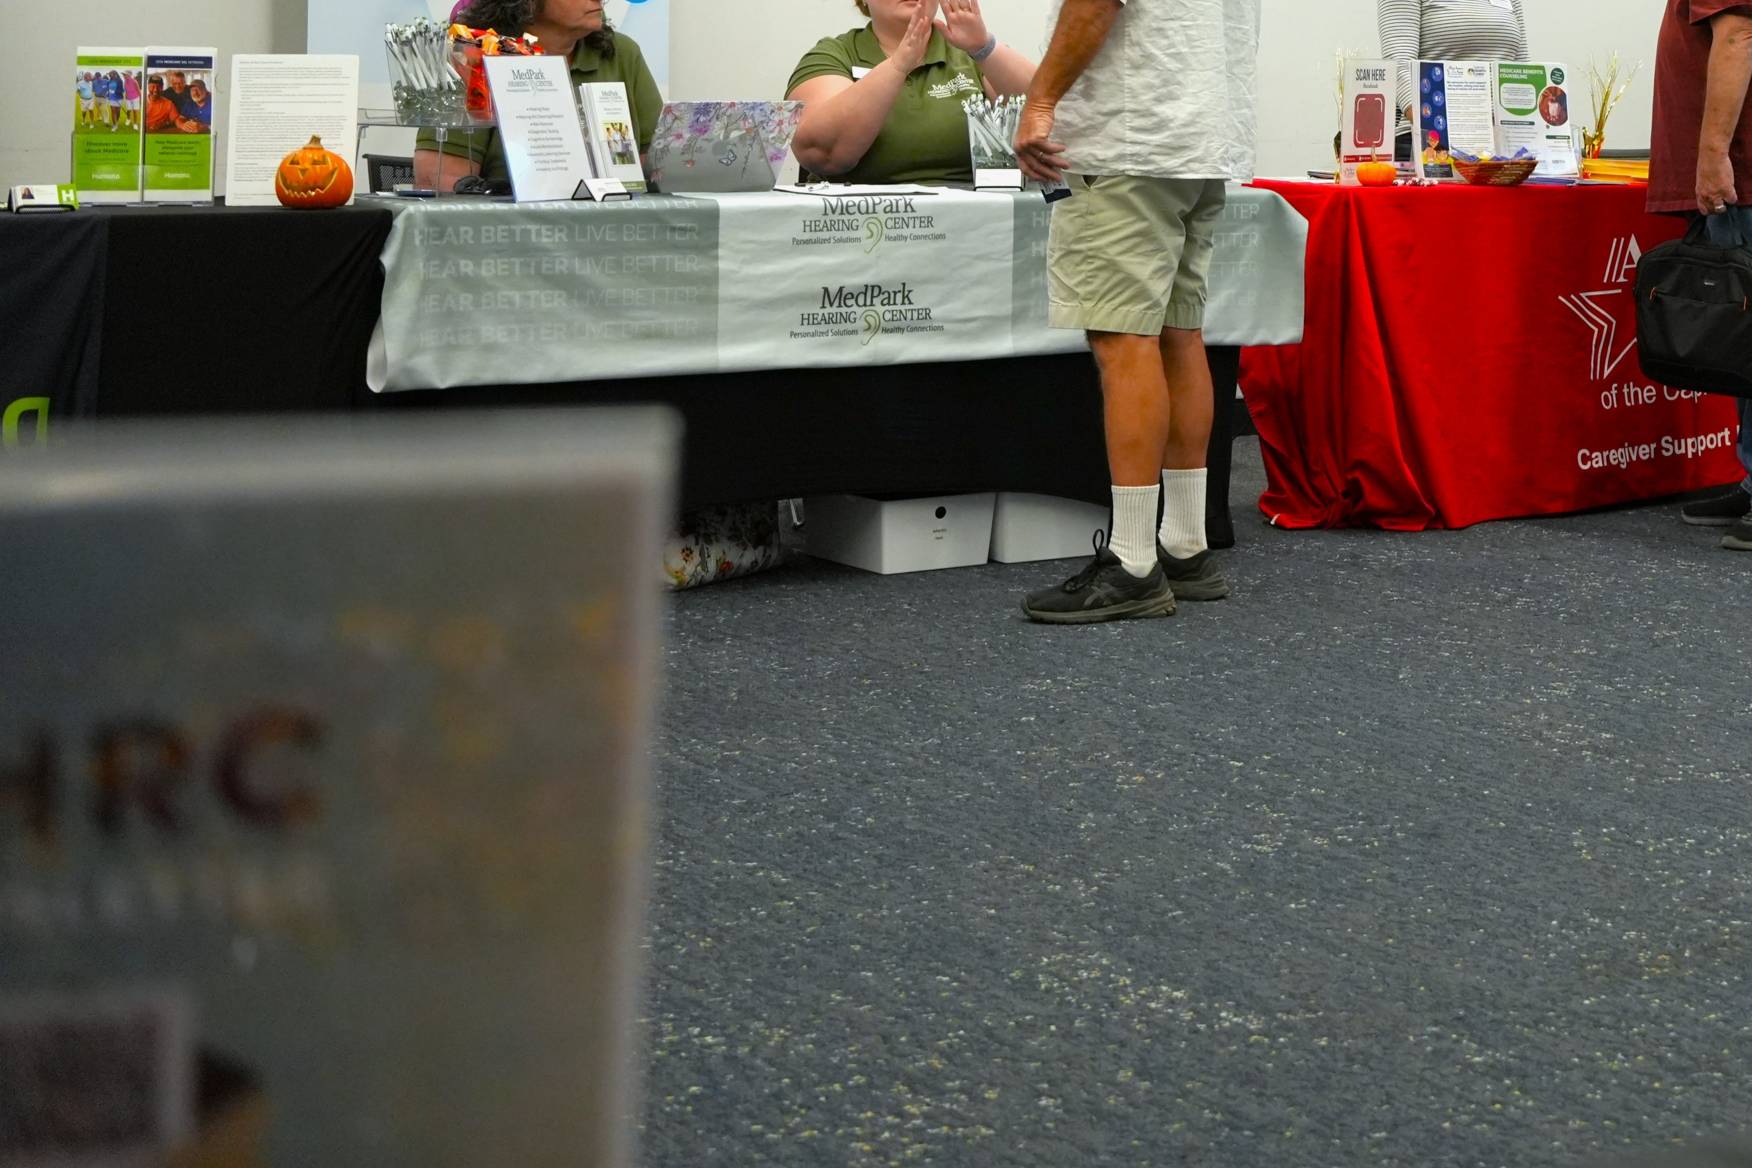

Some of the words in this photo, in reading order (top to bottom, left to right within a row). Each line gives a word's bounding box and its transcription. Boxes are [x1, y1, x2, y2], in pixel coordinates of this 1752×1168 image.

[512, 69, 545, 80] MedPark
[1355, 69, 1371, 81] SCAN
[1371, 69, 1386, 81] HERE
[822, 197, 916, 216] MedPark
[803, 219, 859, 232] HEARING
[885, 216, 934, 229] CENTER
[414, 226, 475, 246] HEAR
[481, 224, 569, 243] BETTER
[575, 224, 616, 242] LIVE
[623, 223, 698, 241] BETTER
[792, 237, 831, 246] Personalized
[885, 234, 907, 242] Healthy
[481, 257, 569, 278] BETTER
[820, 282, 914, 309] MedPark
[800, 311, 857, 326] HEARING
[883, 308, 932, 322] CENTER
[789, 330, 829, 339] Personalized
[830, 329, 858, 337] Solutions
[881, 326, 905, 334] Healthy
[906, 325, 944, 333] Connections
[1601, 384, 1617, 409] of
[1623, 382, 1656, 406] the
[1577, 441, 1656, 470] Caregiver
[1661, 427, 1731, 459] Support
